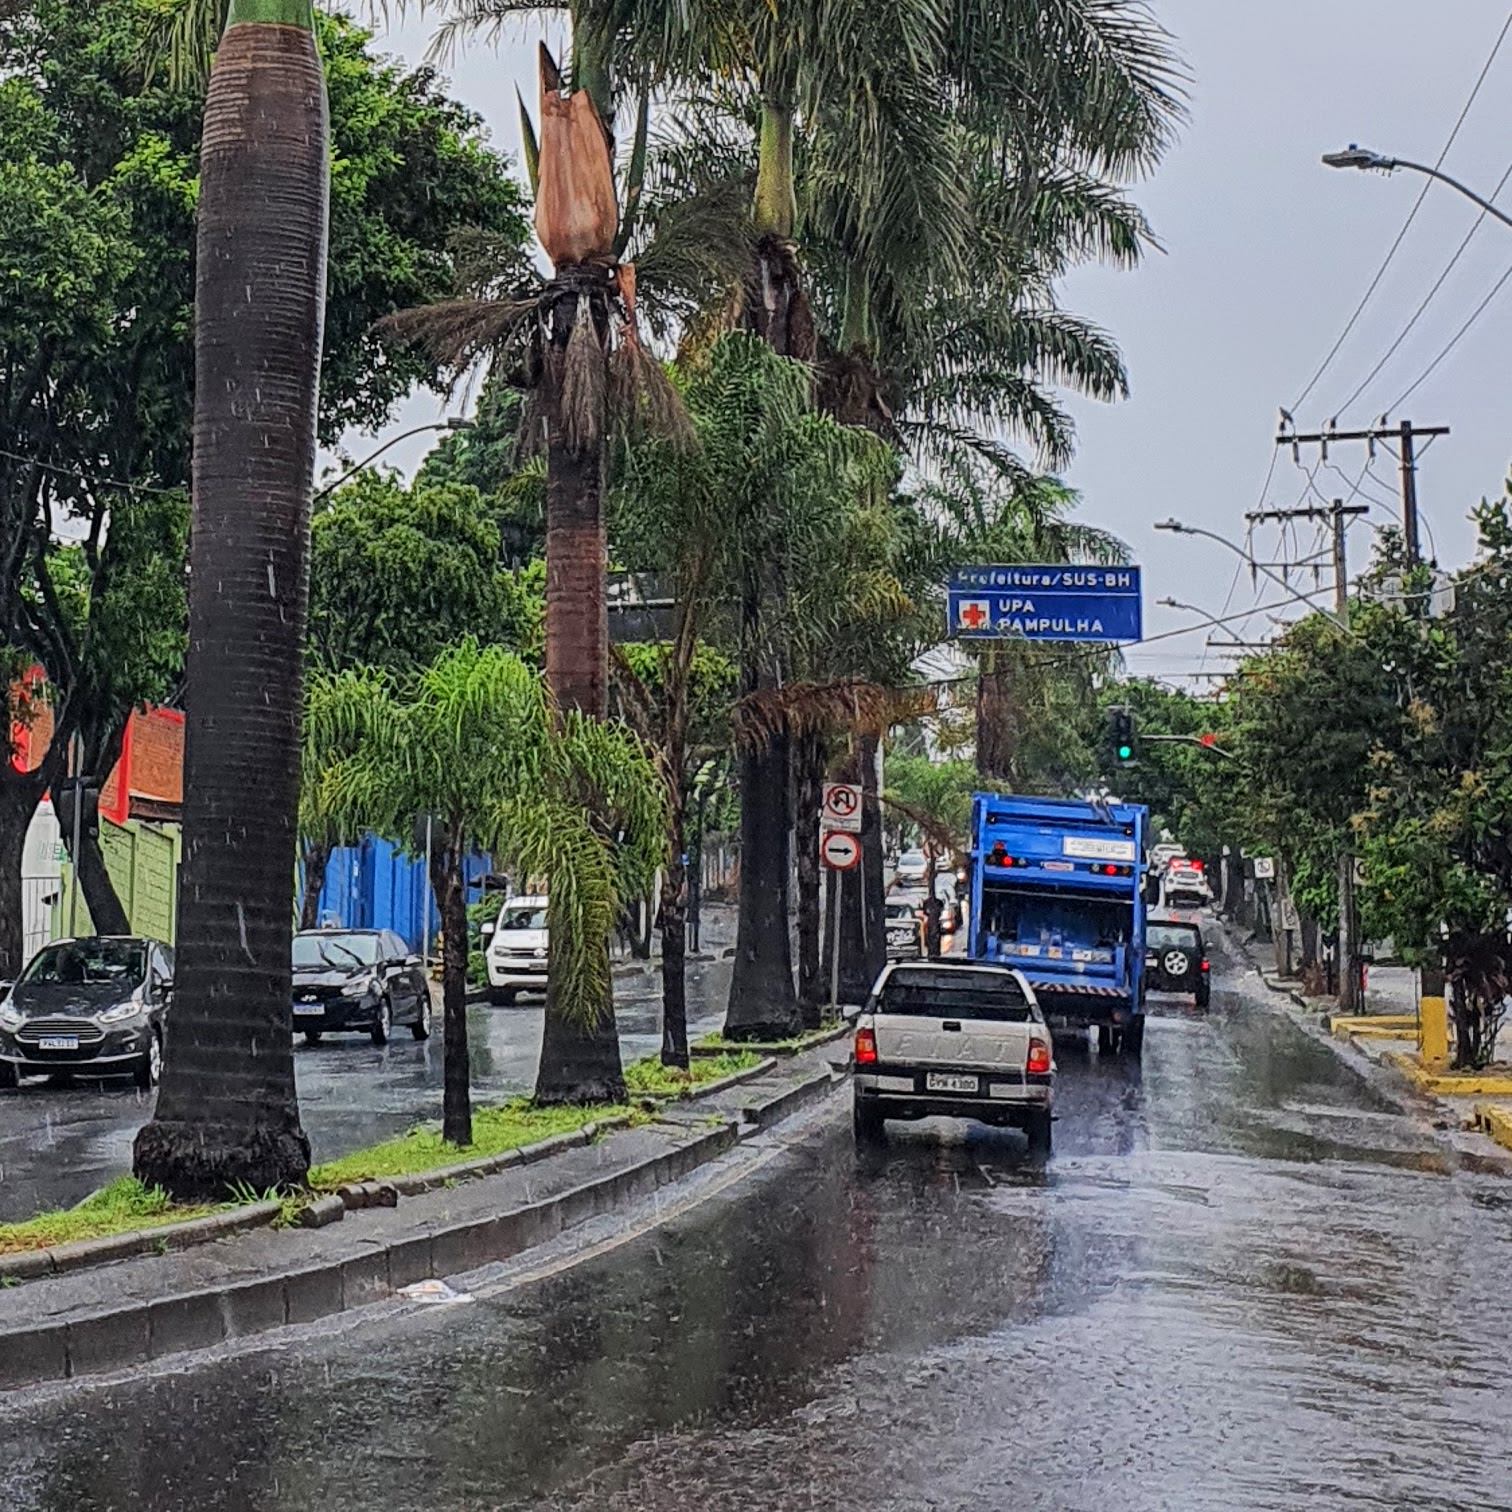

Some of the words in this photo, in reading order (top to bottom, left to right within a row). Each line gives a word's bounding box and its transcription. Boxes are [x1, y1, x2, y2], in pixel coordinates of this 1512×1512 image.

[999, 599, 1036, 613] UPA
[1000, 618, 1104, 633] PAMPULHA
[894, 1034, 1010, 1062] FIAT
